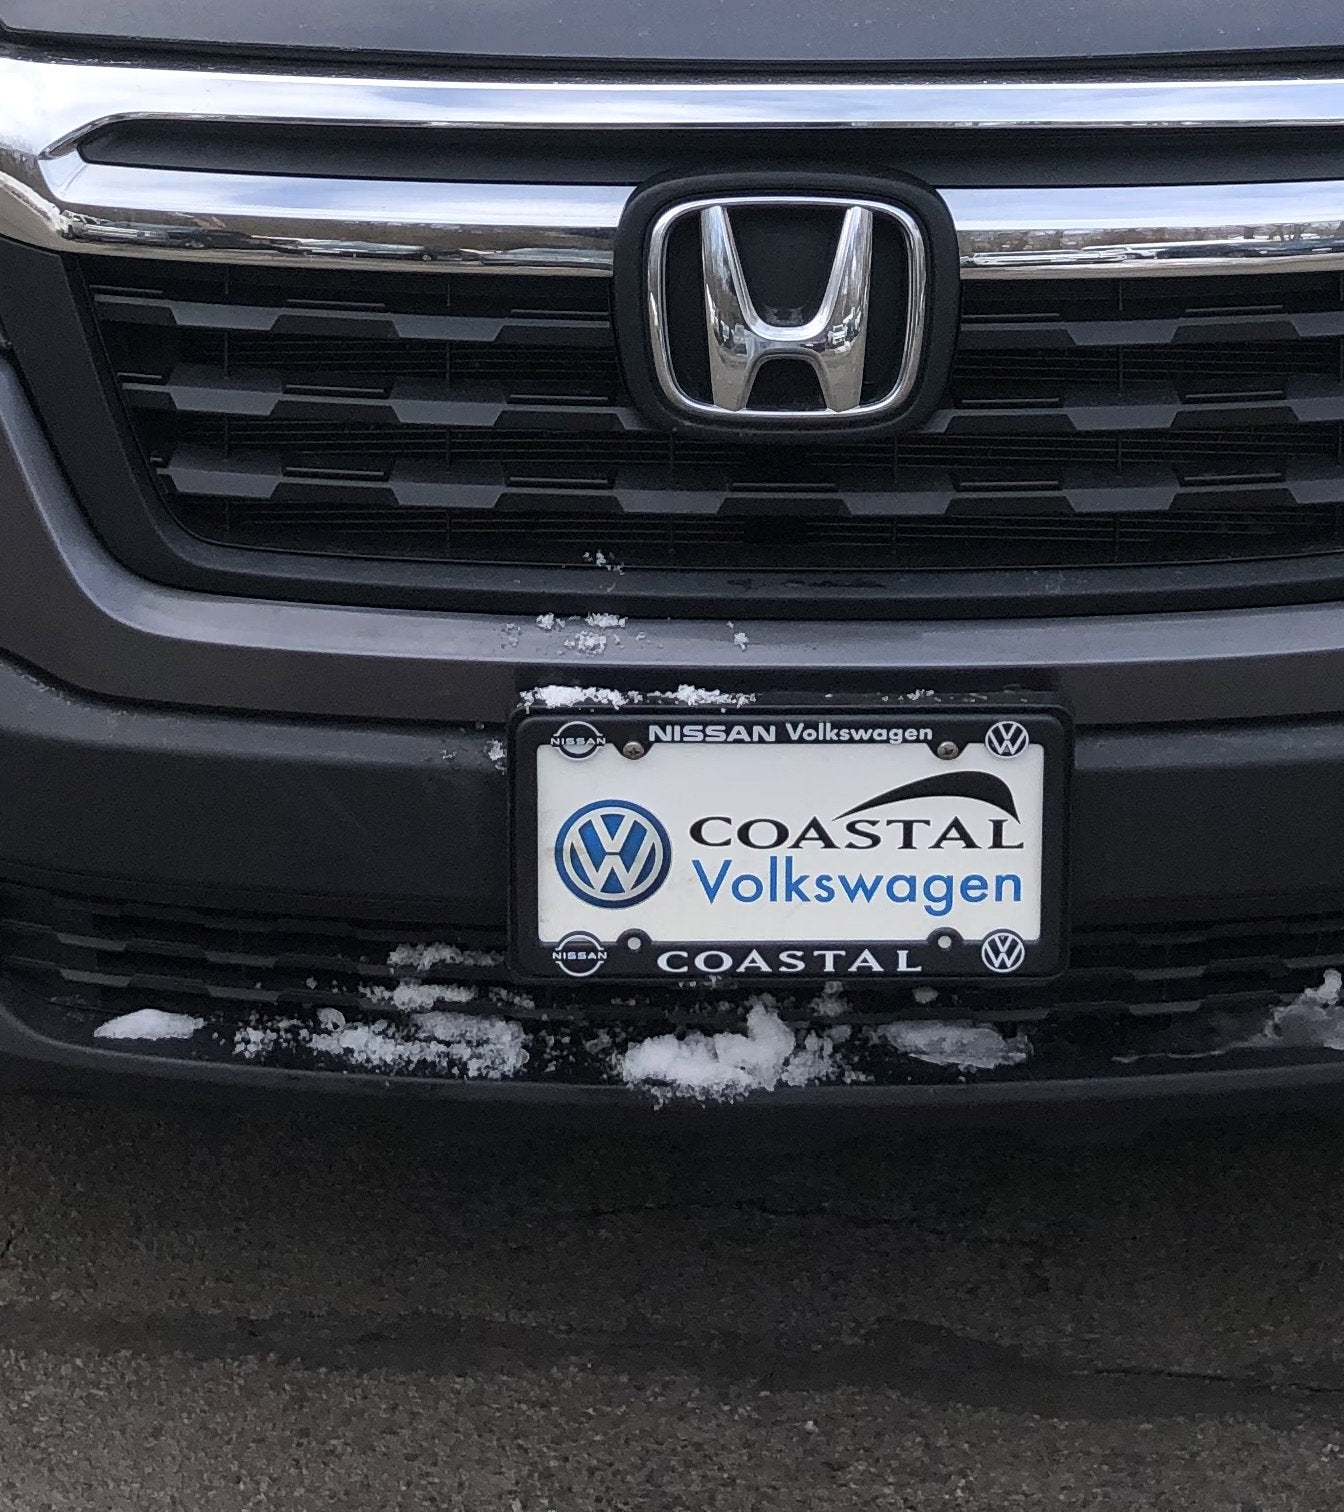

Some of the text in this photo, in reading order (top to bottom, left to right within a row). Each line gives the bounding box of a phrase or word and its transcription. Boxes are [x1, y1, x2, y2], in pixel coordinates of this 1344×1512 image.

[551, 737, 606, 746] NISSAN
[649, 721, 934, 745] NISSAN Volkswagen
[689, 816, 1025, 851] COASTAL
[691, 856, 1023, 917] Volkswagen
[552, 950, 608, 960] NISSAN
[657, 948, 923, 973] COASTAL
